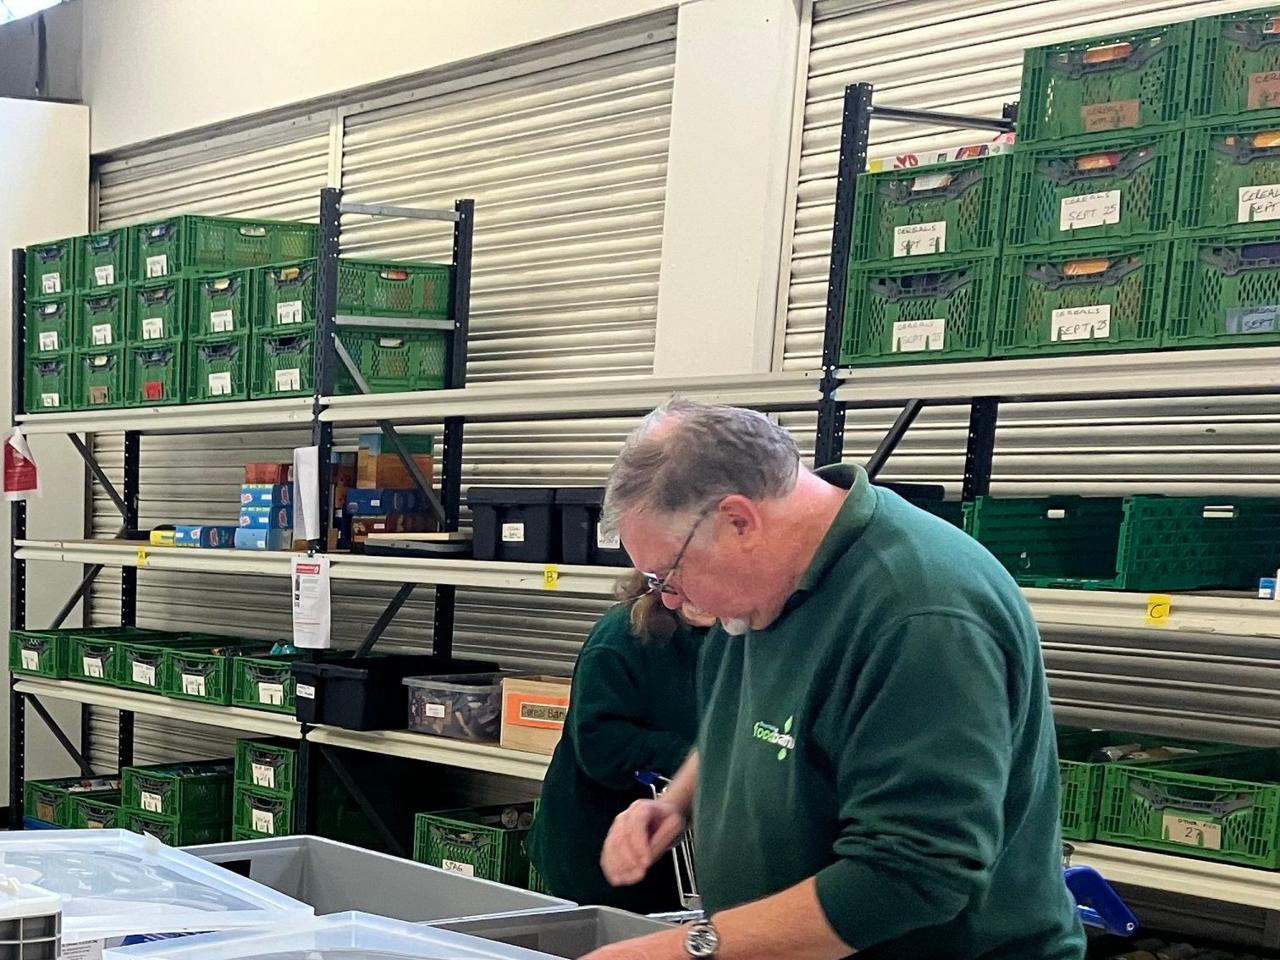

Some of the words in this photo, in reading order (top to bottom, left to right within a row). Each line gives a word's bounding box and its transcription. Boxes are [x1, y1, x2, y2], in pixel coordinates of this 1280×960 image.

[1068, 208, 1097, 222] SEPT
[1059, 322, 1090, 336] SEPT
[546, 571, 554, 583] B
[1150, 604, 1164, 619] C
